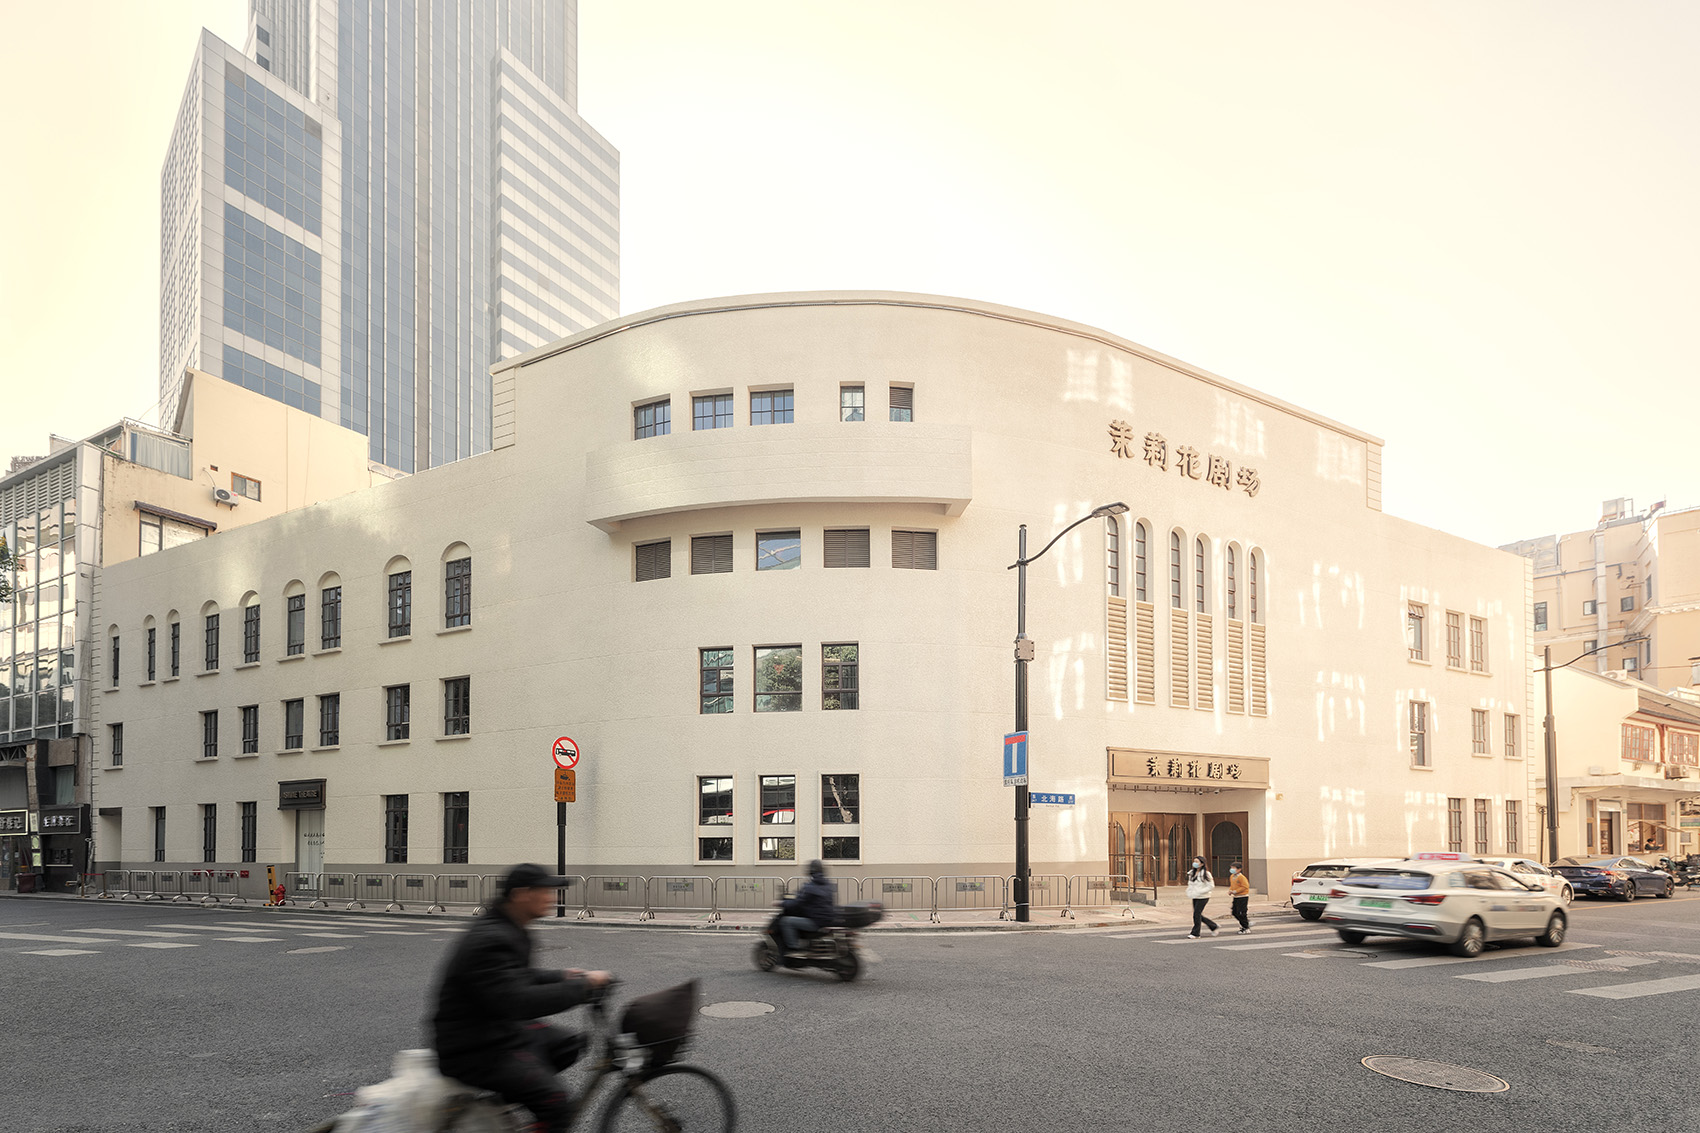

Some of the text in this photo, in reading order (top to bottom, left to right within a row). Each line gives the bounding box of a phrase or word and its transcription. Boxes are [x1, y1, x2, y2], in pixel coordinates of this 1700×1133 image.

[1107, 419, 1262, 497] 茉莉花剧场
[1146, 756, 1243, 780] 茉莉花剧场
[1041, 795, 1065, 803] 北海路
